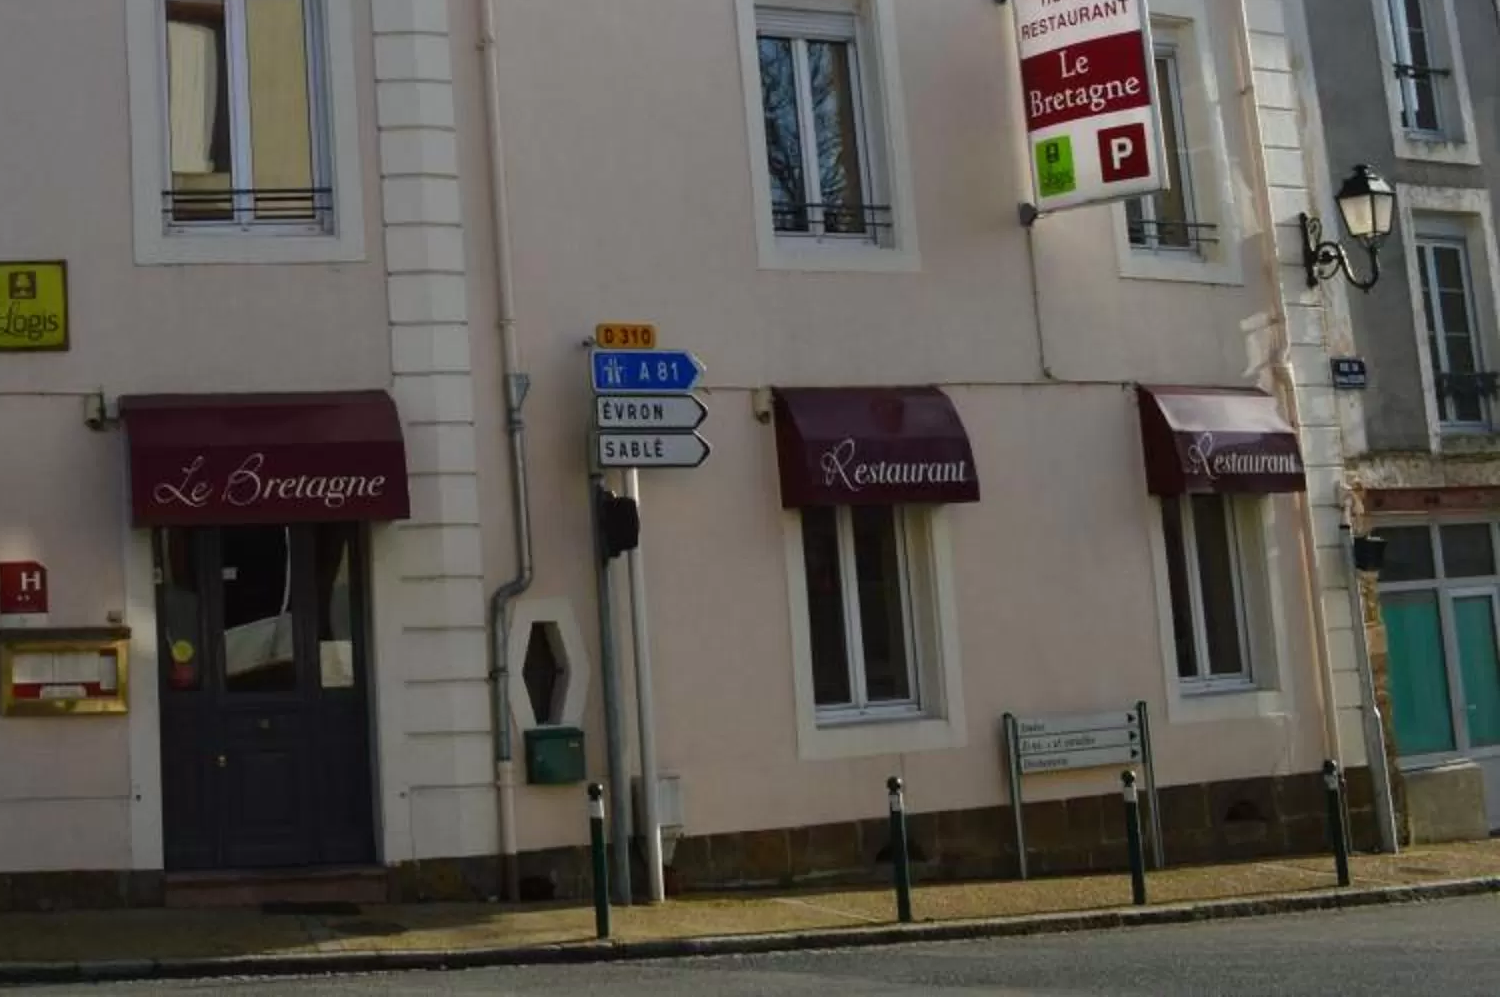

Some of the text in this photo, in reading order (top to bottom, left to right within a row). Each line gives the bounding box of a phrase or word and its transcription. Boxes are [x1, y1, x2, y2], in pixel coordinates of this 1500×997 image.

[1059, 51, 1090, 79] Le
[1029, 76, 1141, 118] Bretagne
[1111, 137, 1133, 170] P
[603, 329, 651, 344] D 310
[639, 361, 679, 381] A 81
[603, 401, 664, 421] ÉVRON
[605, 438, 664, 458] SABLÉ
[1188, 431, 1297, 480] Restaurant
[820, 438, 967, 492] Restaurant
[154, 453, 386, 508] Le Bretagne
[20, 570, 41, 591] H
